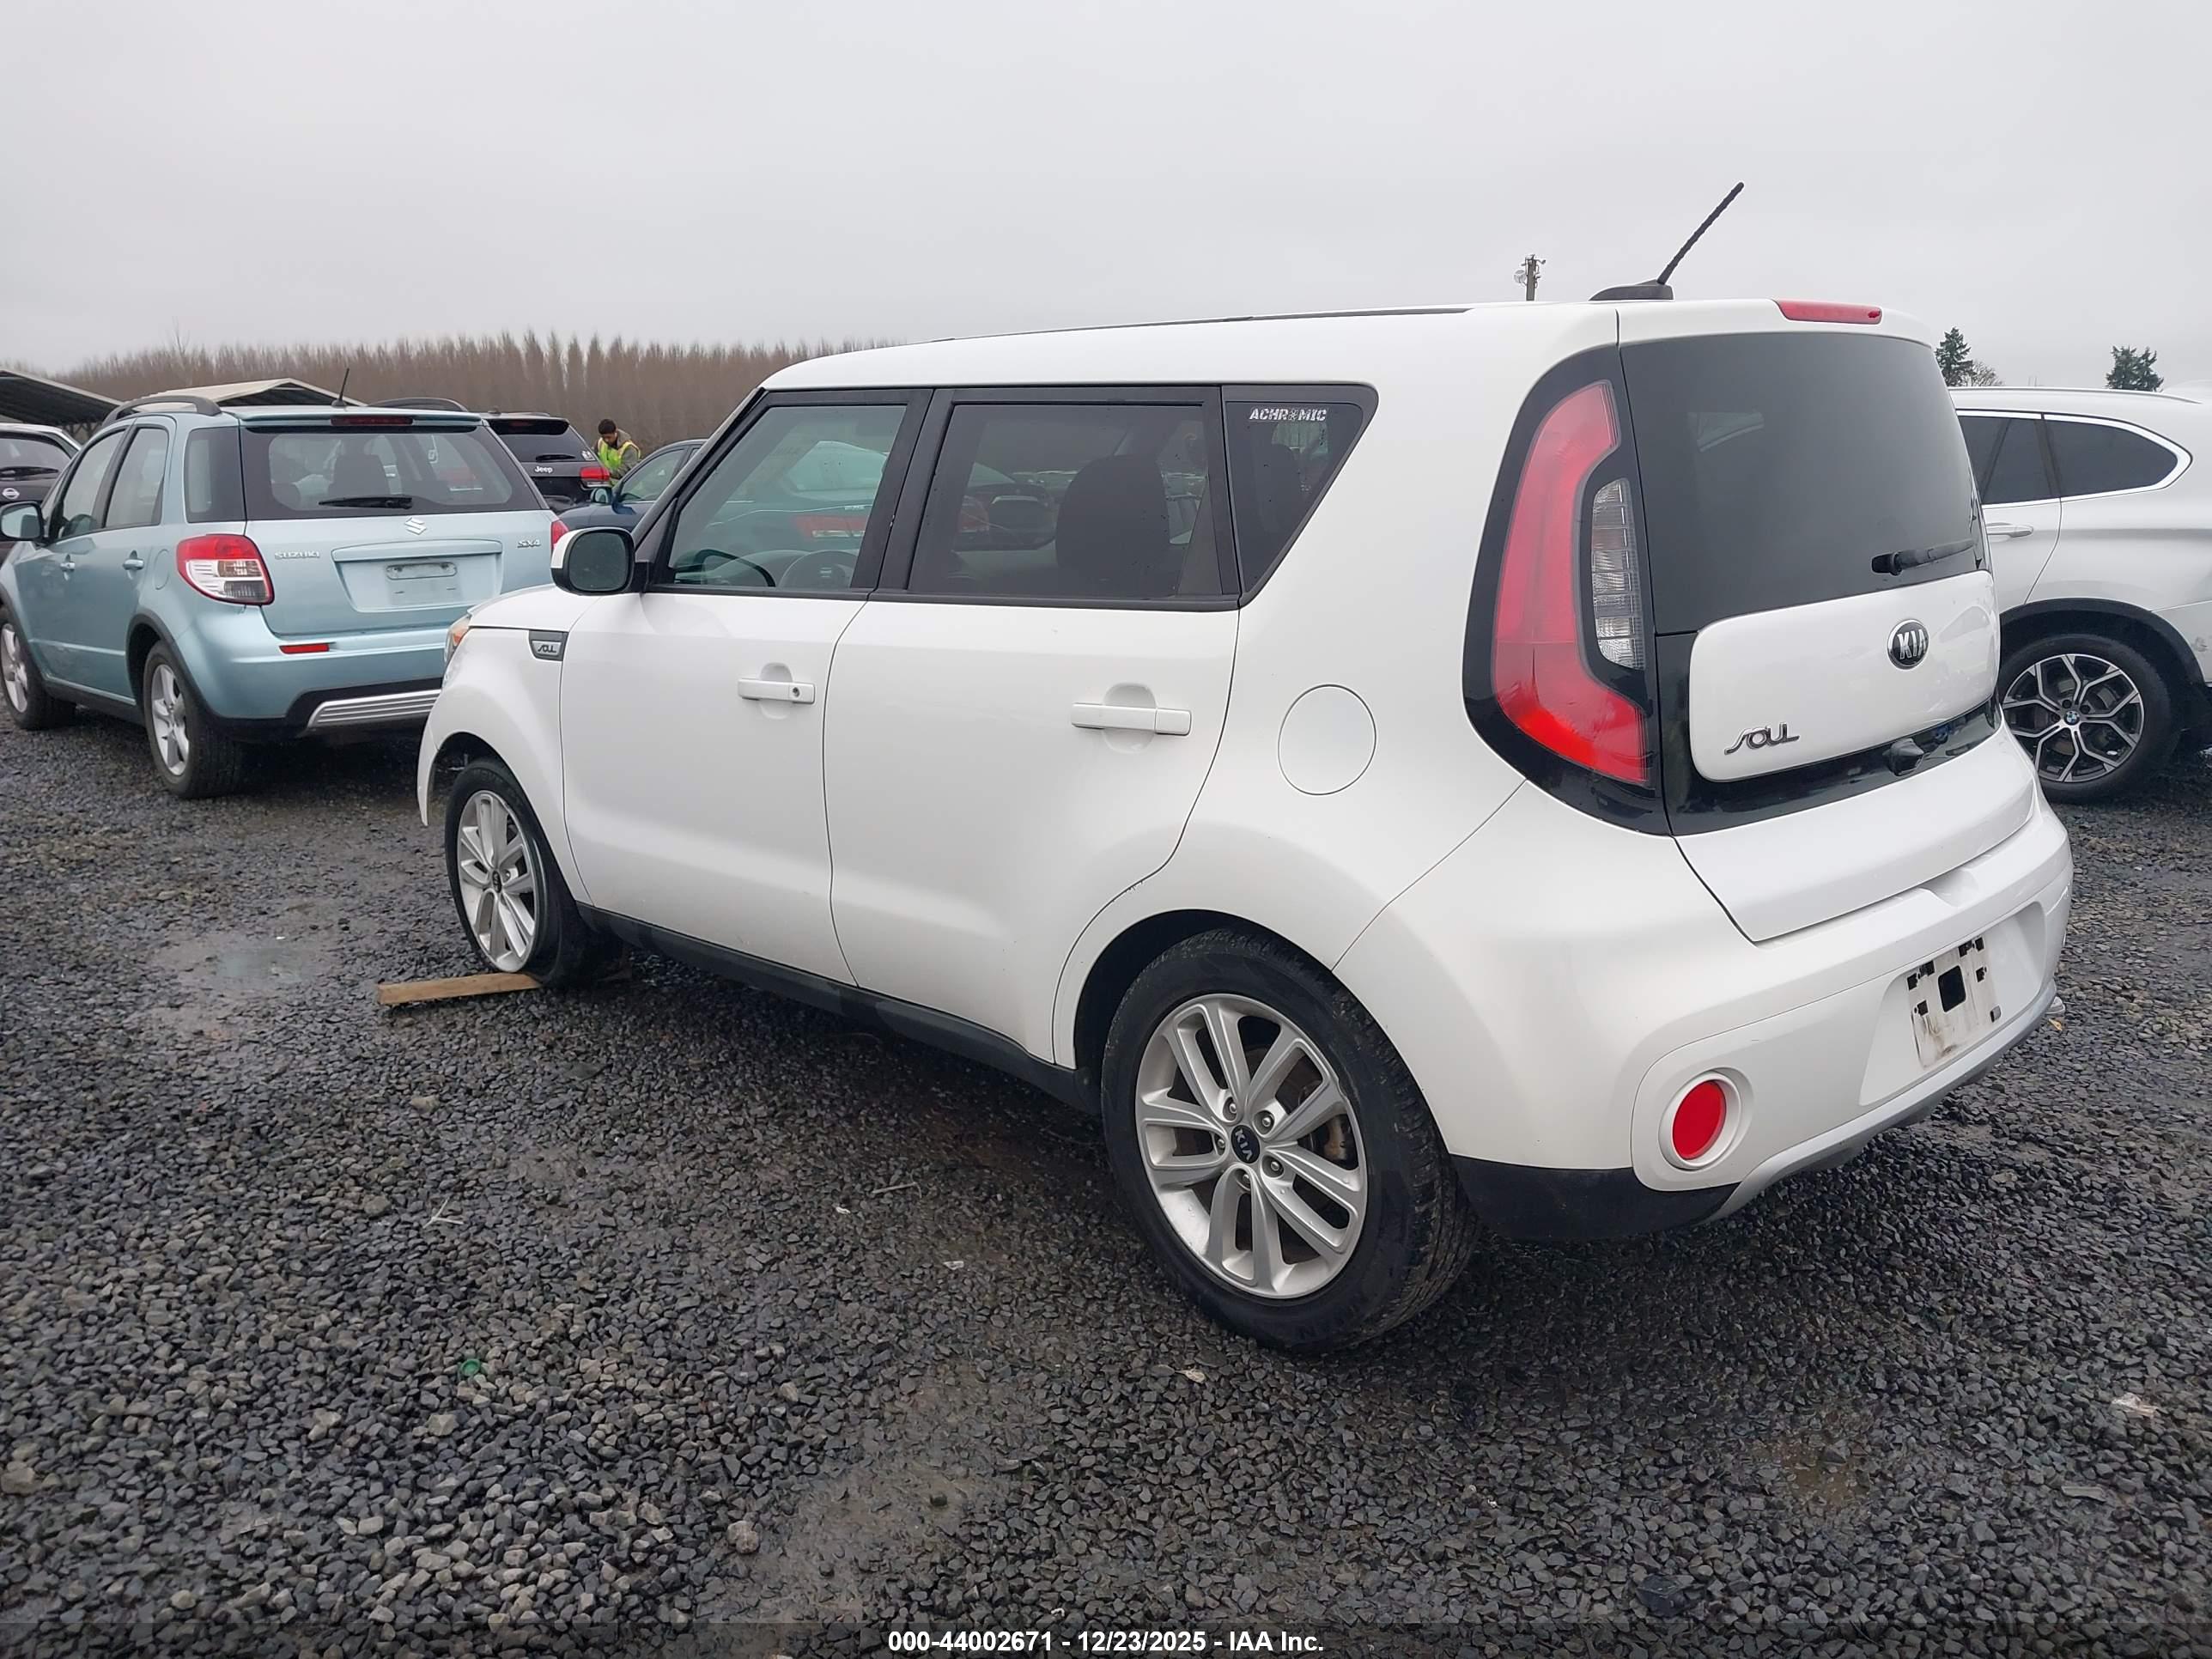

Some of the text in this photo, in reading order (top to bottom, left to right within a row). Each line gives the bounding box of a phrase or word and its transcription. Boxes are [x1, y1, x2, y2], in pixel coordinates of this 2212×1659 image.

[1897, 629, 1928, 659] KIA
[1723, 722, 1800, 756] SOUL
[1235, 1128, 1253, 1161] KIA
